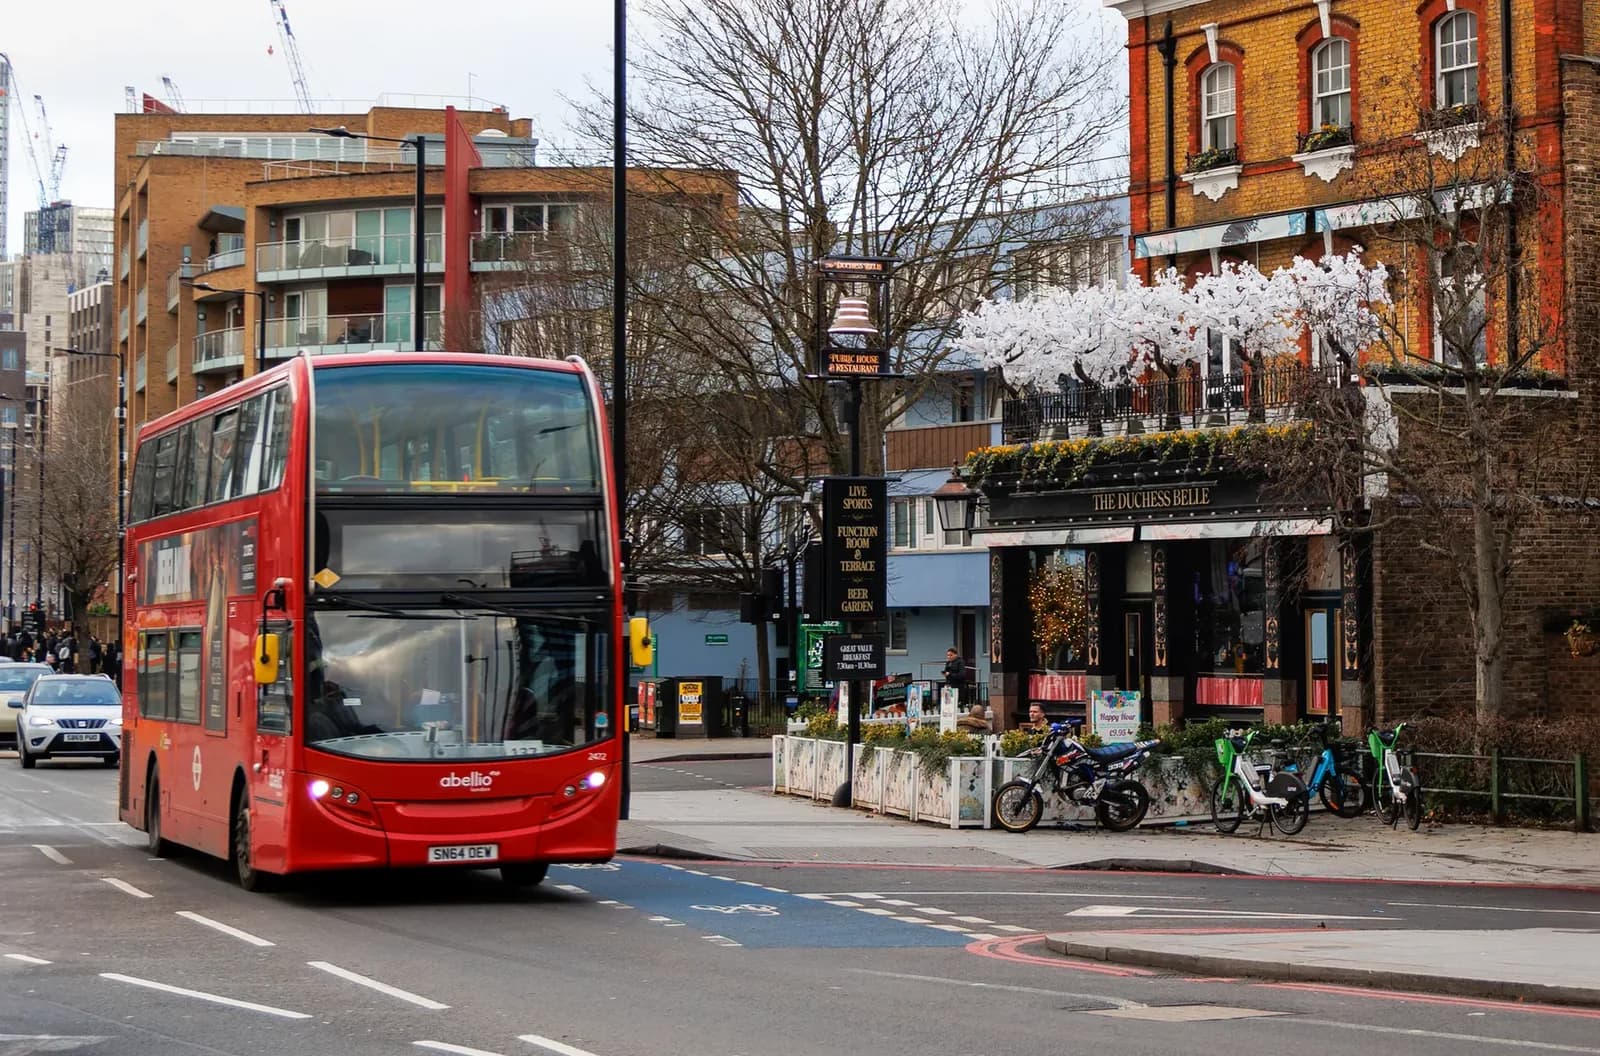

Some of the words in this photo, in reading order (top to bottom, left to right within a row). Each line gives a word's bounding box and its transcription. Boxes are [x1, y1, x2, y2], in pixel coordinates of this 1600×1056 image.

[829, 353, 855, 363] PUBLIC
[856, 354, 879, 363] HOUSE
[836, 364, 880, 373] RESTAURANT
[849, 486, 867, 496] LIVE
[843, 499, 873, 509] SPORTS
[1093, 494, 1116, 511] THE
[1118, 490, 1171, 509] DUCHESS
[1173, 487, 1210, 506] BELLE
[838, 526, 879, 537] FUNCTION
[846, 538, 870, 549] ROOM
[840, 561, 876, 571] TERRACE
[847, 588, 869, 599] BEER
[841, 601, 874, 612] GARDEN
[840, 645, 857, 653] GREAT
[857, 644, 873, 652] VALUE
[842, 653, 871, 661] BREAKFAST
[1100, 712, 1120, 722] Happy
[1121, 712, 1136, 720] Hour
[440, 771, 492, 787] abellio
[433, 848, 465, 860] SN64
[469, 846, 492, 858] OEW
